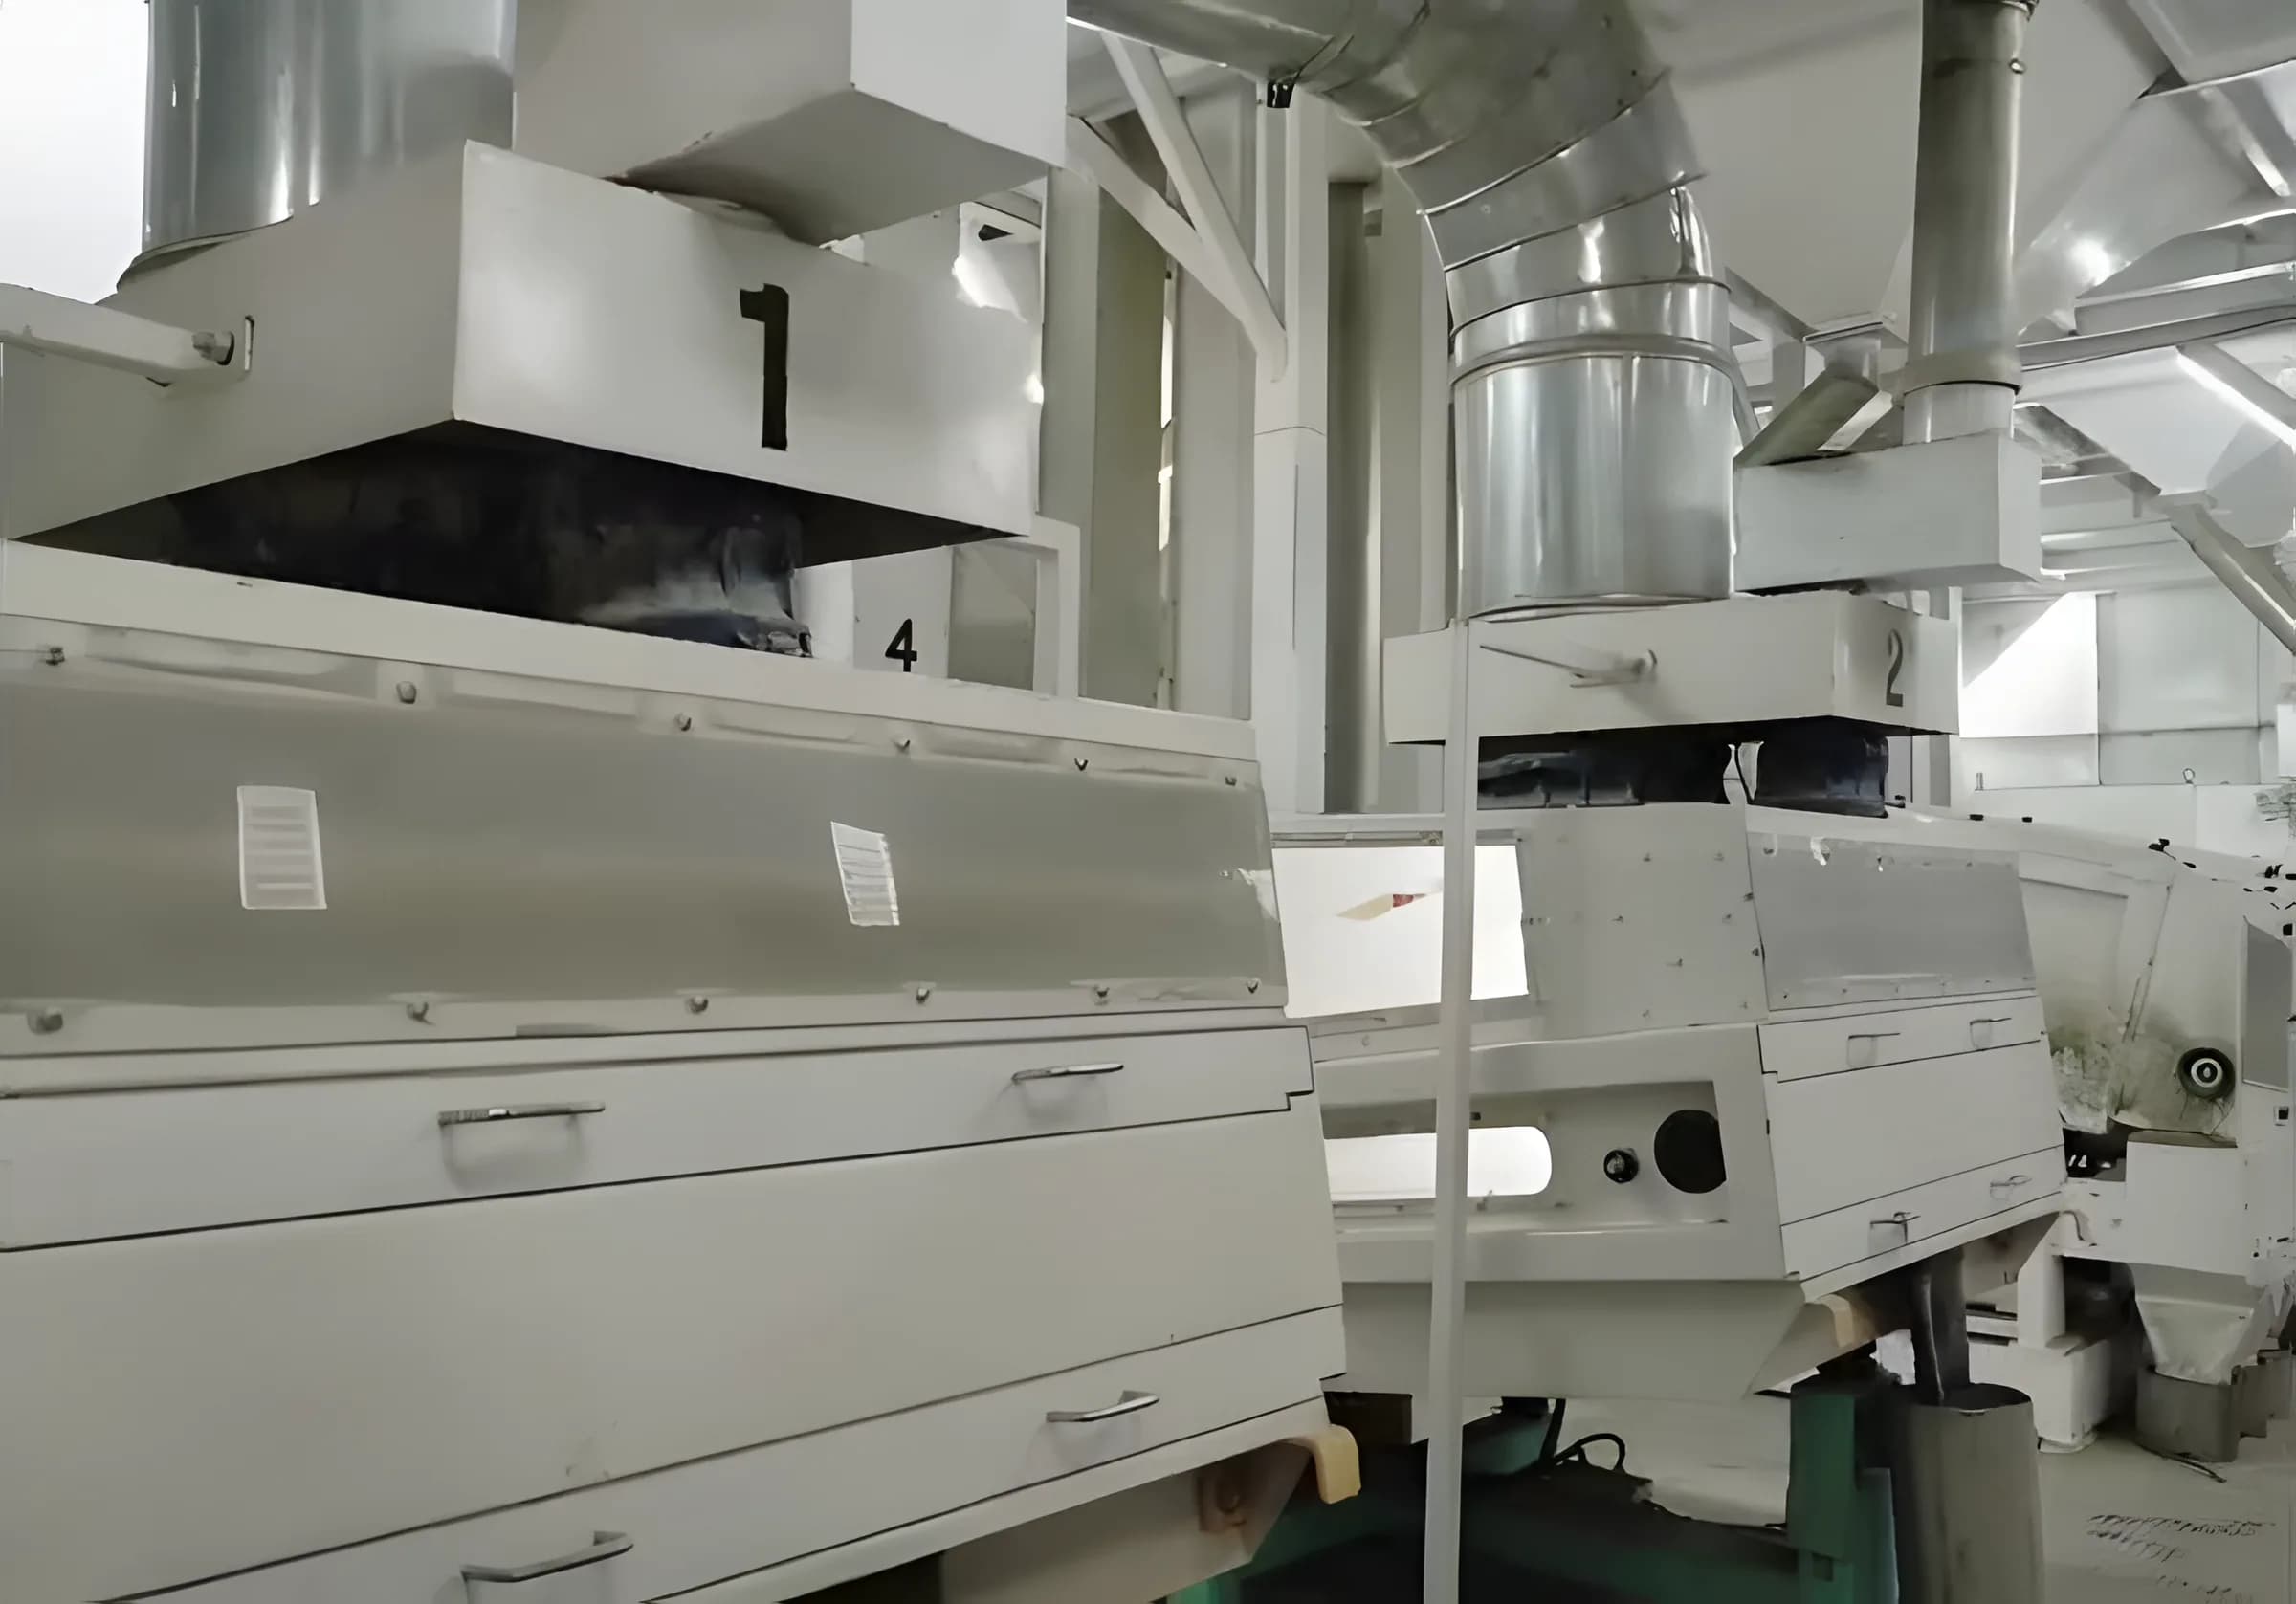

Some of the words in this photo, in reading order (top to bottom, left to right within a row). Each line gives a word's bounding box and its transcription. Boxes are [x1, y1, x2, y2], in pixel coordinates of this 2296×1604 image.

[740, 283, 789, 450] 1
[885, 618, 917, 672] 4
[1886, 628, 1904, 707] 2
